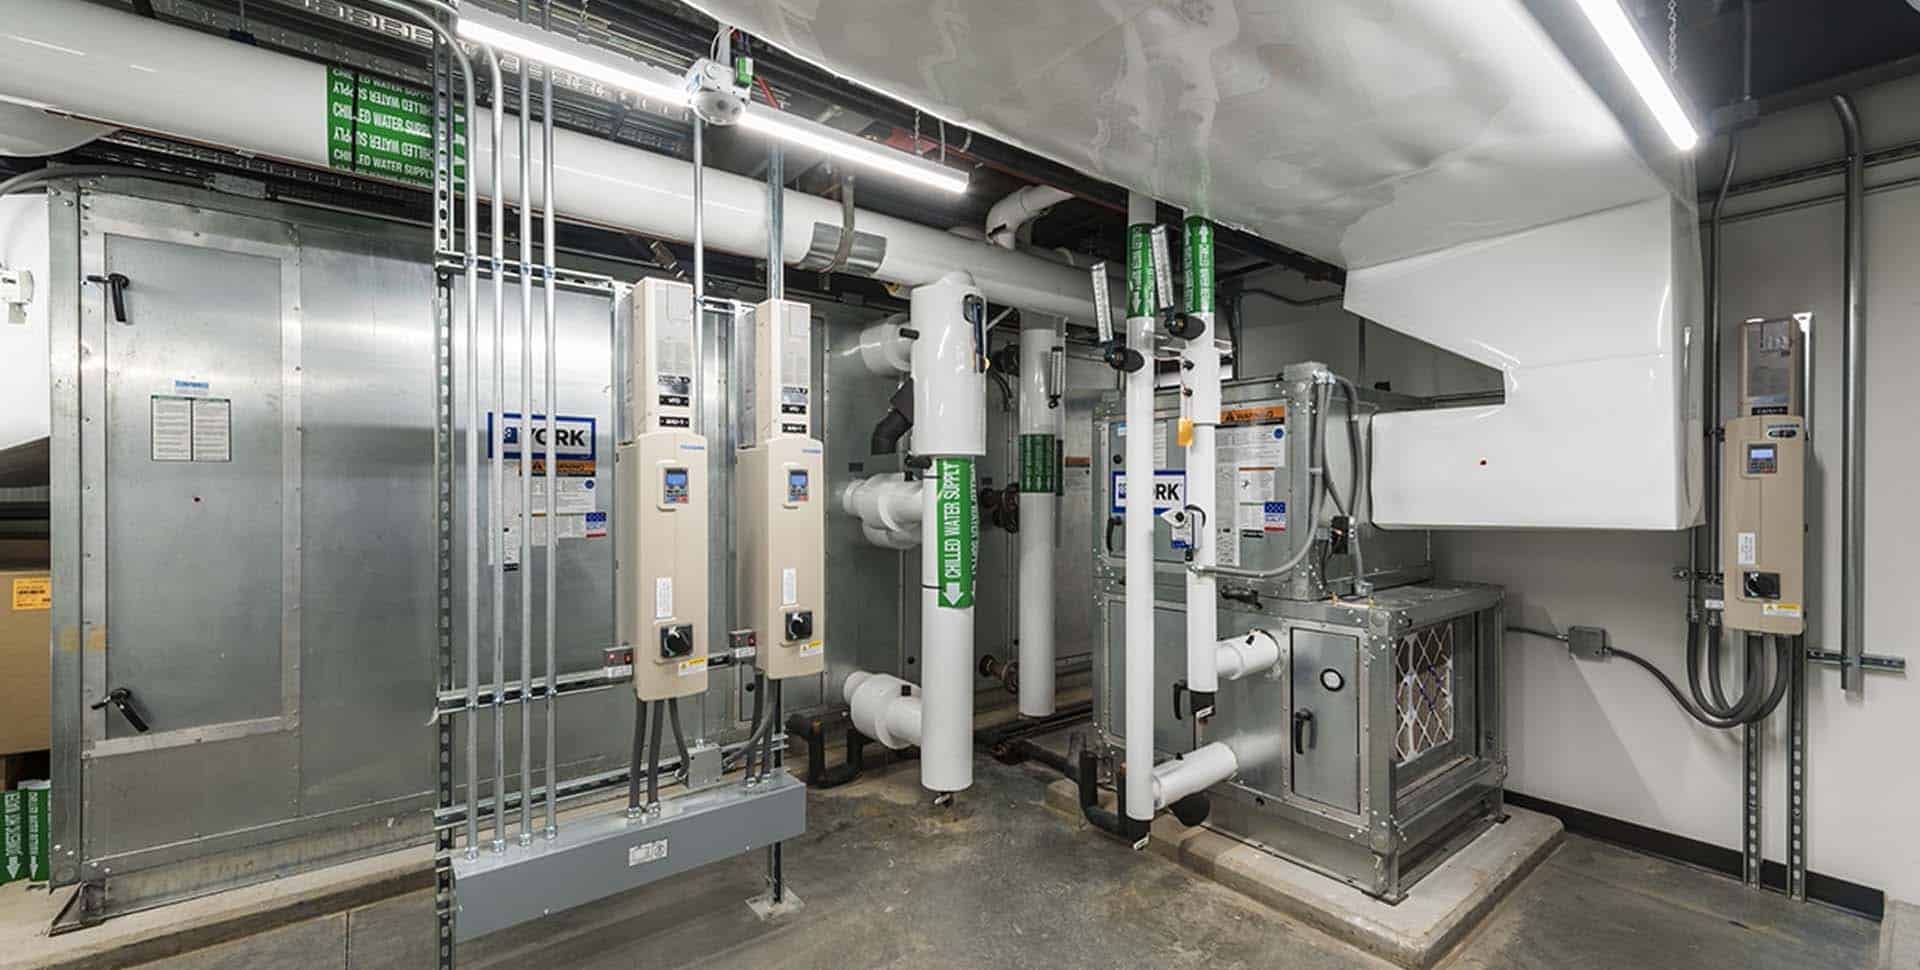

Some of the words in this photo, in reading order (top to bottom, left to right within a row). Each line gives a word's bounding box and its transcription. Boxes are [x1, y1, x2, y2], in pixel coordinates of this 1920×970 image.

[334, 81, 368, 100] SPPLY
[369, 90, 401, 109] WATER
[333, 102, 371, 124] CHILED
[373, 111, 403, 132] WATER
[369, 134, 401, 154] WATER
[334, 149, 371, 166] CHILED
[372, 157, 402, 173] WATER
[943, 462, 961, 500] SUPPLY
[944, 502, 961, 536] WATER
[944, 538, 961, 578] CHILLED
